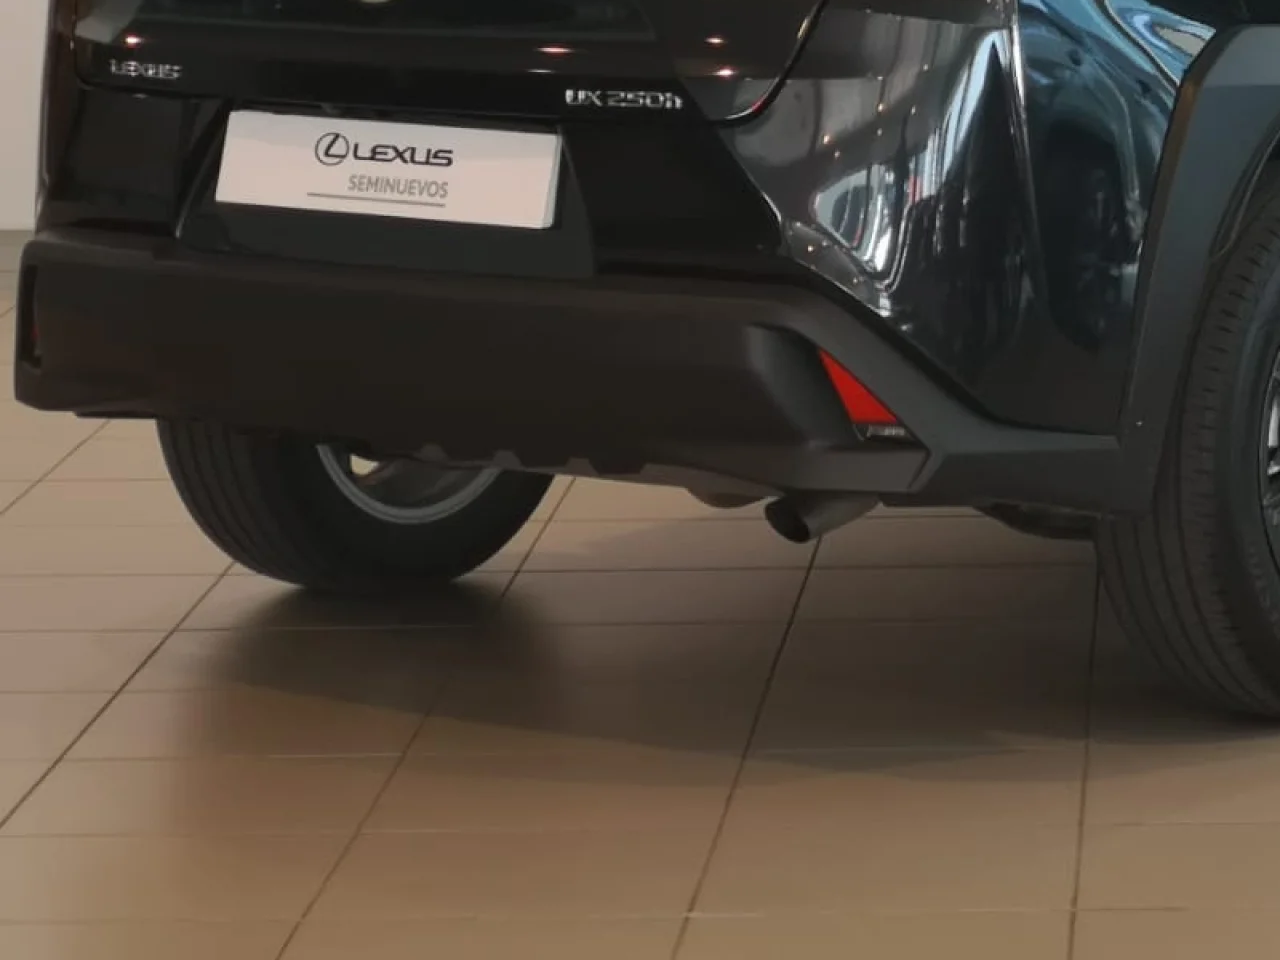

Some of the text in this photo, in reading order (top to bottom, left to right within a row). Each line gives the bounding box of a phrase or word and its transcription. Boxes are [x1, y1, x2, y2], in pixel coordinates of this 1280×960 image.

[110, 59, 181, 79] LEXUS
[353, 142, 453, 167] LEXUS
[348, 174, 449, 199] SEMINUEVOS
